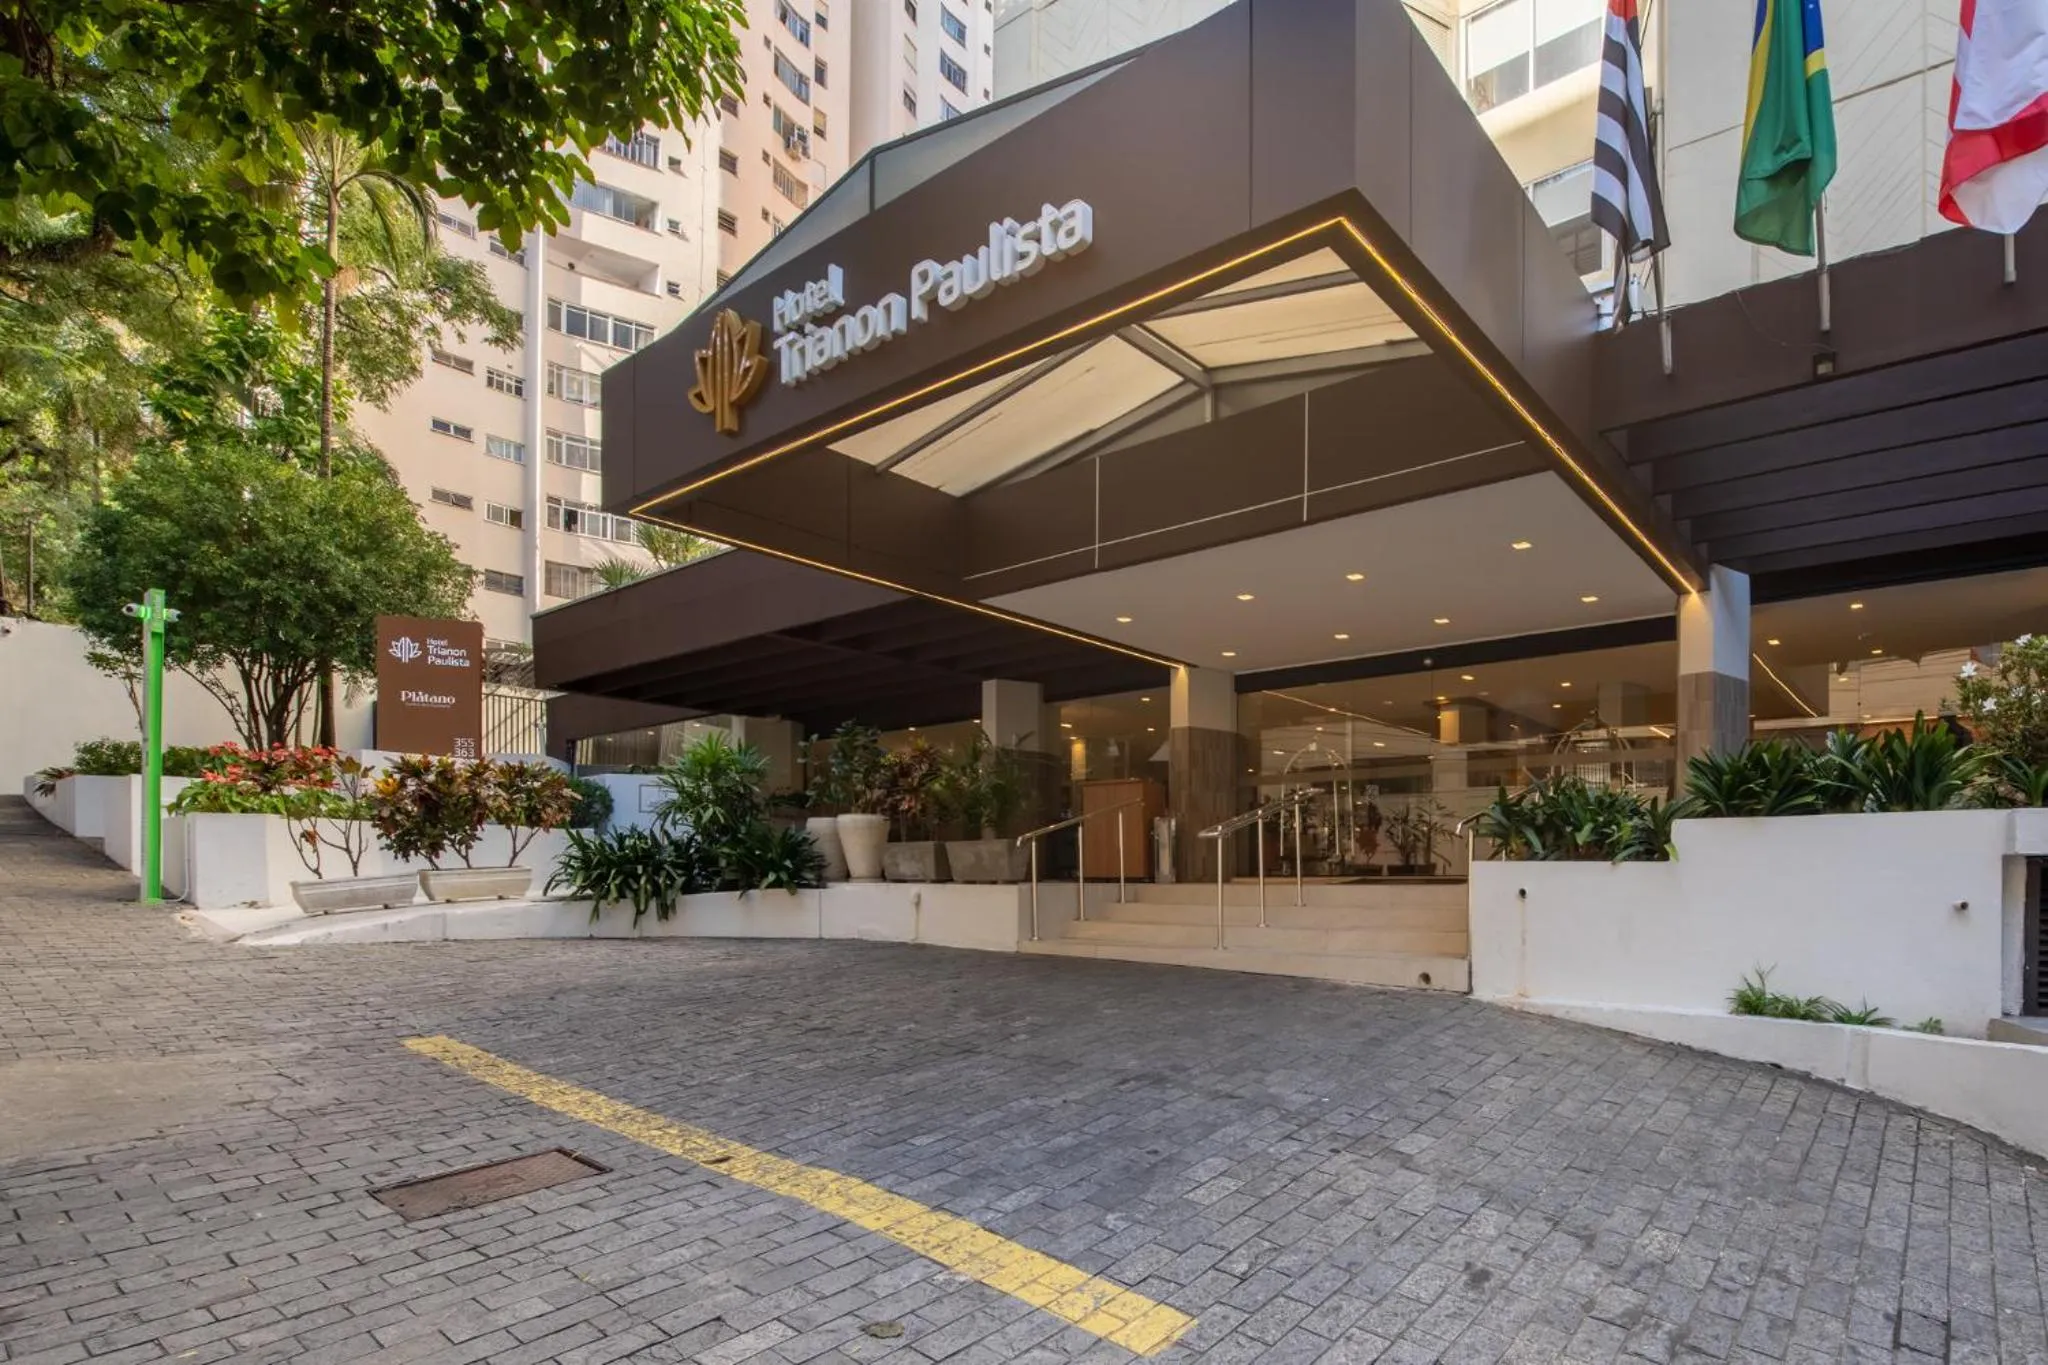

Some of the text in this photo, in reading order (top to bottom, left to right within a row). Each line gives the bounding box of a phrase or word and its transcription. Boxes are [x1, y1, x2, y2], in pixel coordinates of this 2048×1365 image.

[772, 263, 845, 332] Hotel
[773, 198, 1094, 387] Trianon Paulista
[426, 638, 449, 646] Hotel
[426, 645, 467, 657] Trianon
[428, 655, 470, 667] Paulista
[453, 737, 475, 748] 355
[454, 747, 475, 758] 363
